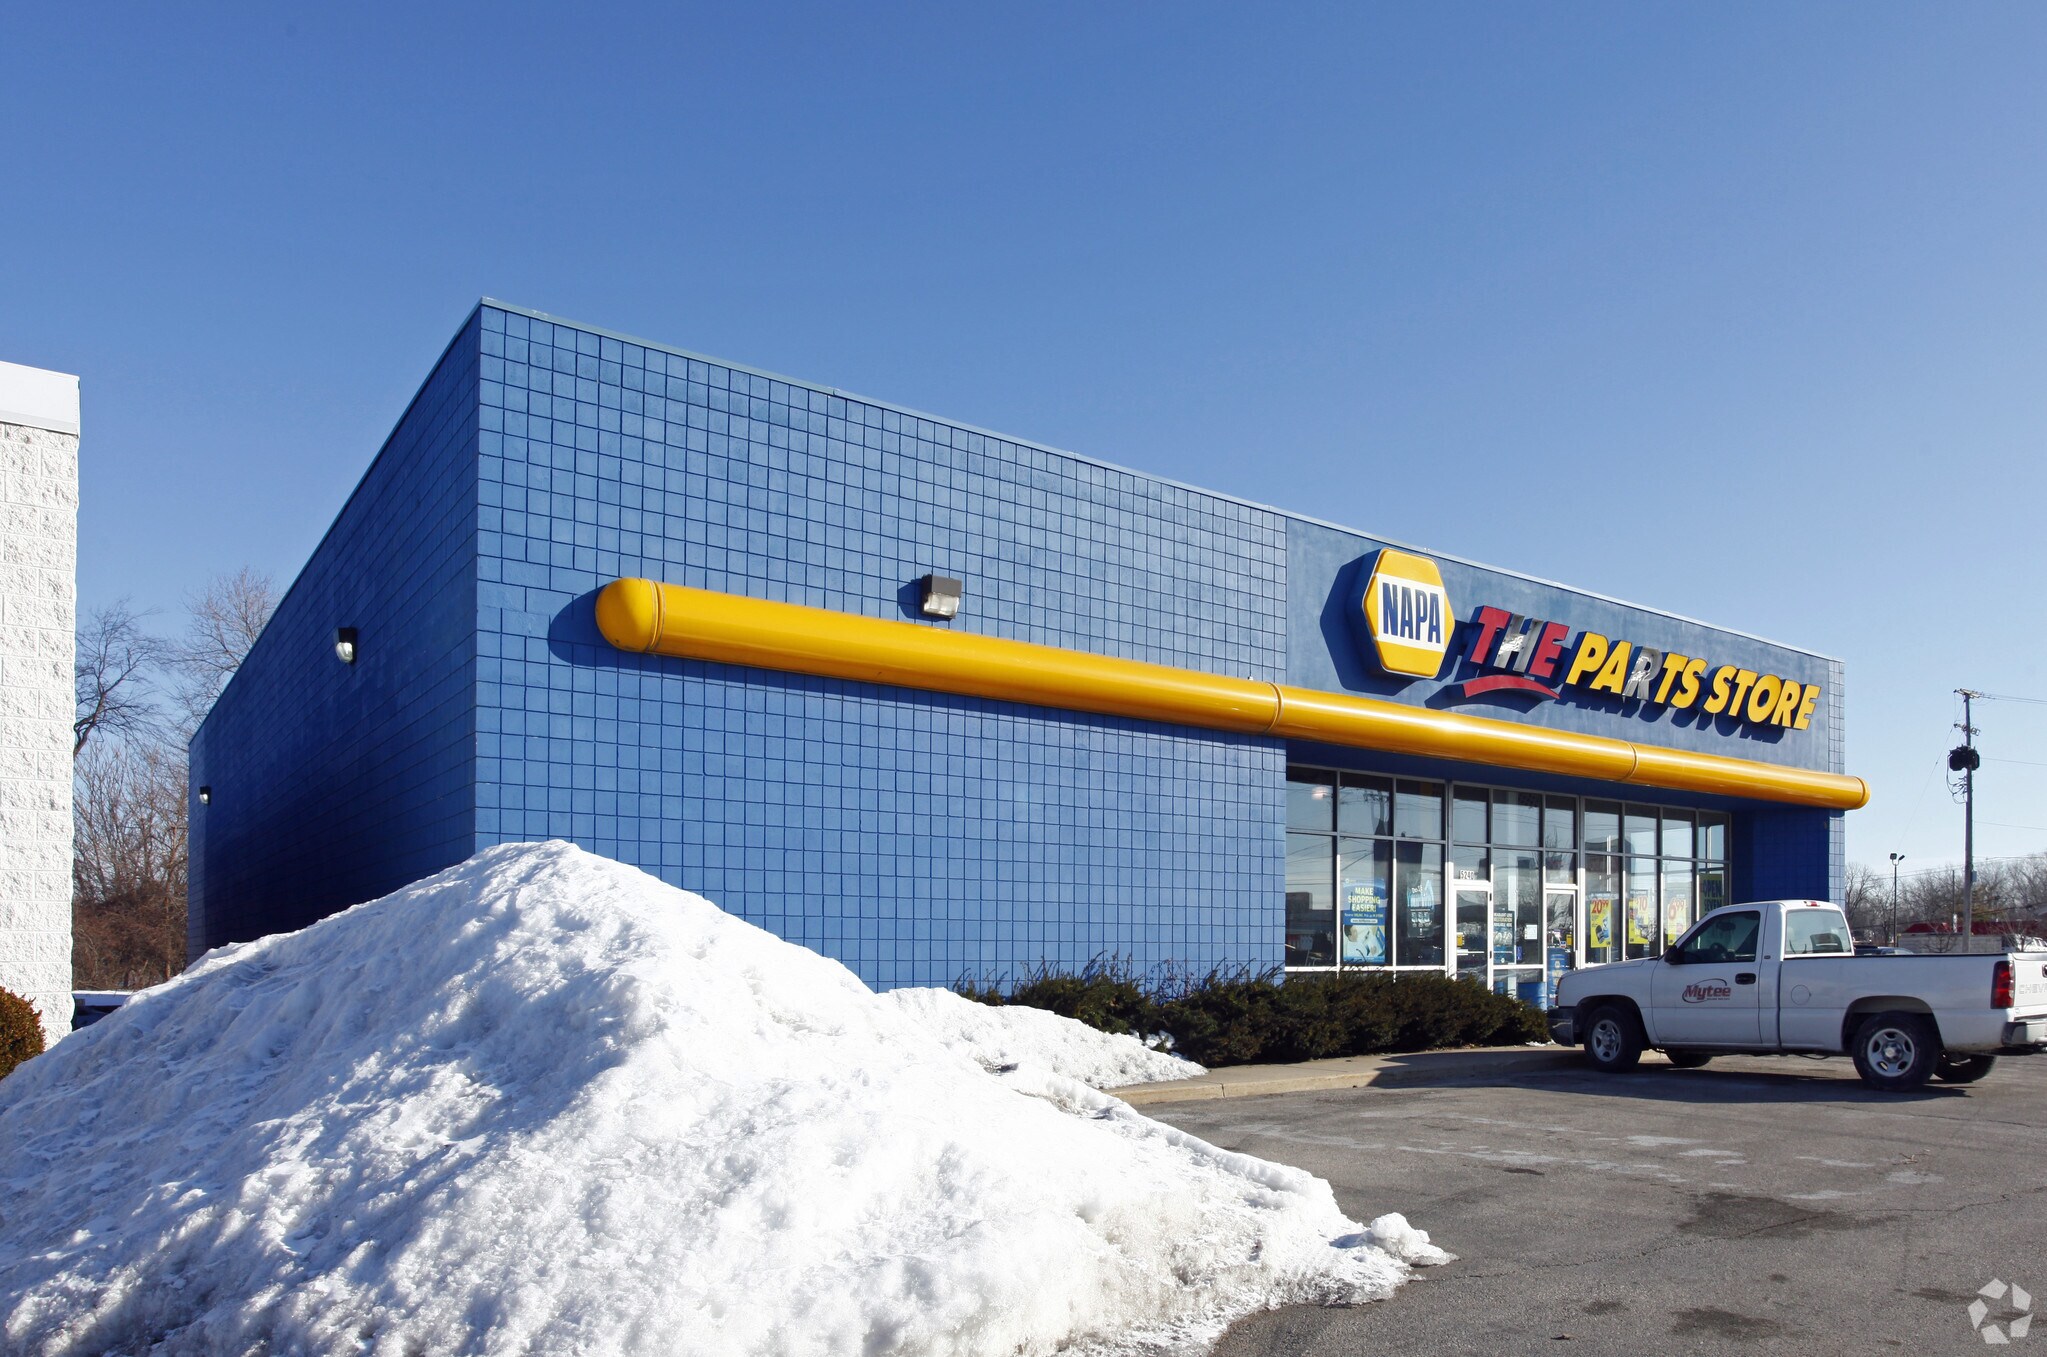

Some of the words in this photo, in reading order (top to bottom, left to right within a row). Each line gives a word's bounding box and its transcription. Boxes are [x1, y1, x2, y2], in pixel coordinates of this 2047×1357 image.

[1382, 582, 1441, 644] NAPA
[1470, 605, 1569, 678] THE
[1565, 631, 1708, 708] PARTS
[1703, 665, 1821, 730] STORE
[1354, 887, 1374, 895] MAKE
[1703, 880, 1723, 898] OPEN
[1347, 895, 1381, 904] SHOPPING
[1351, 904, 1377, 912] EASIER!
[1685, 985, 1731, 1000] Mytee
